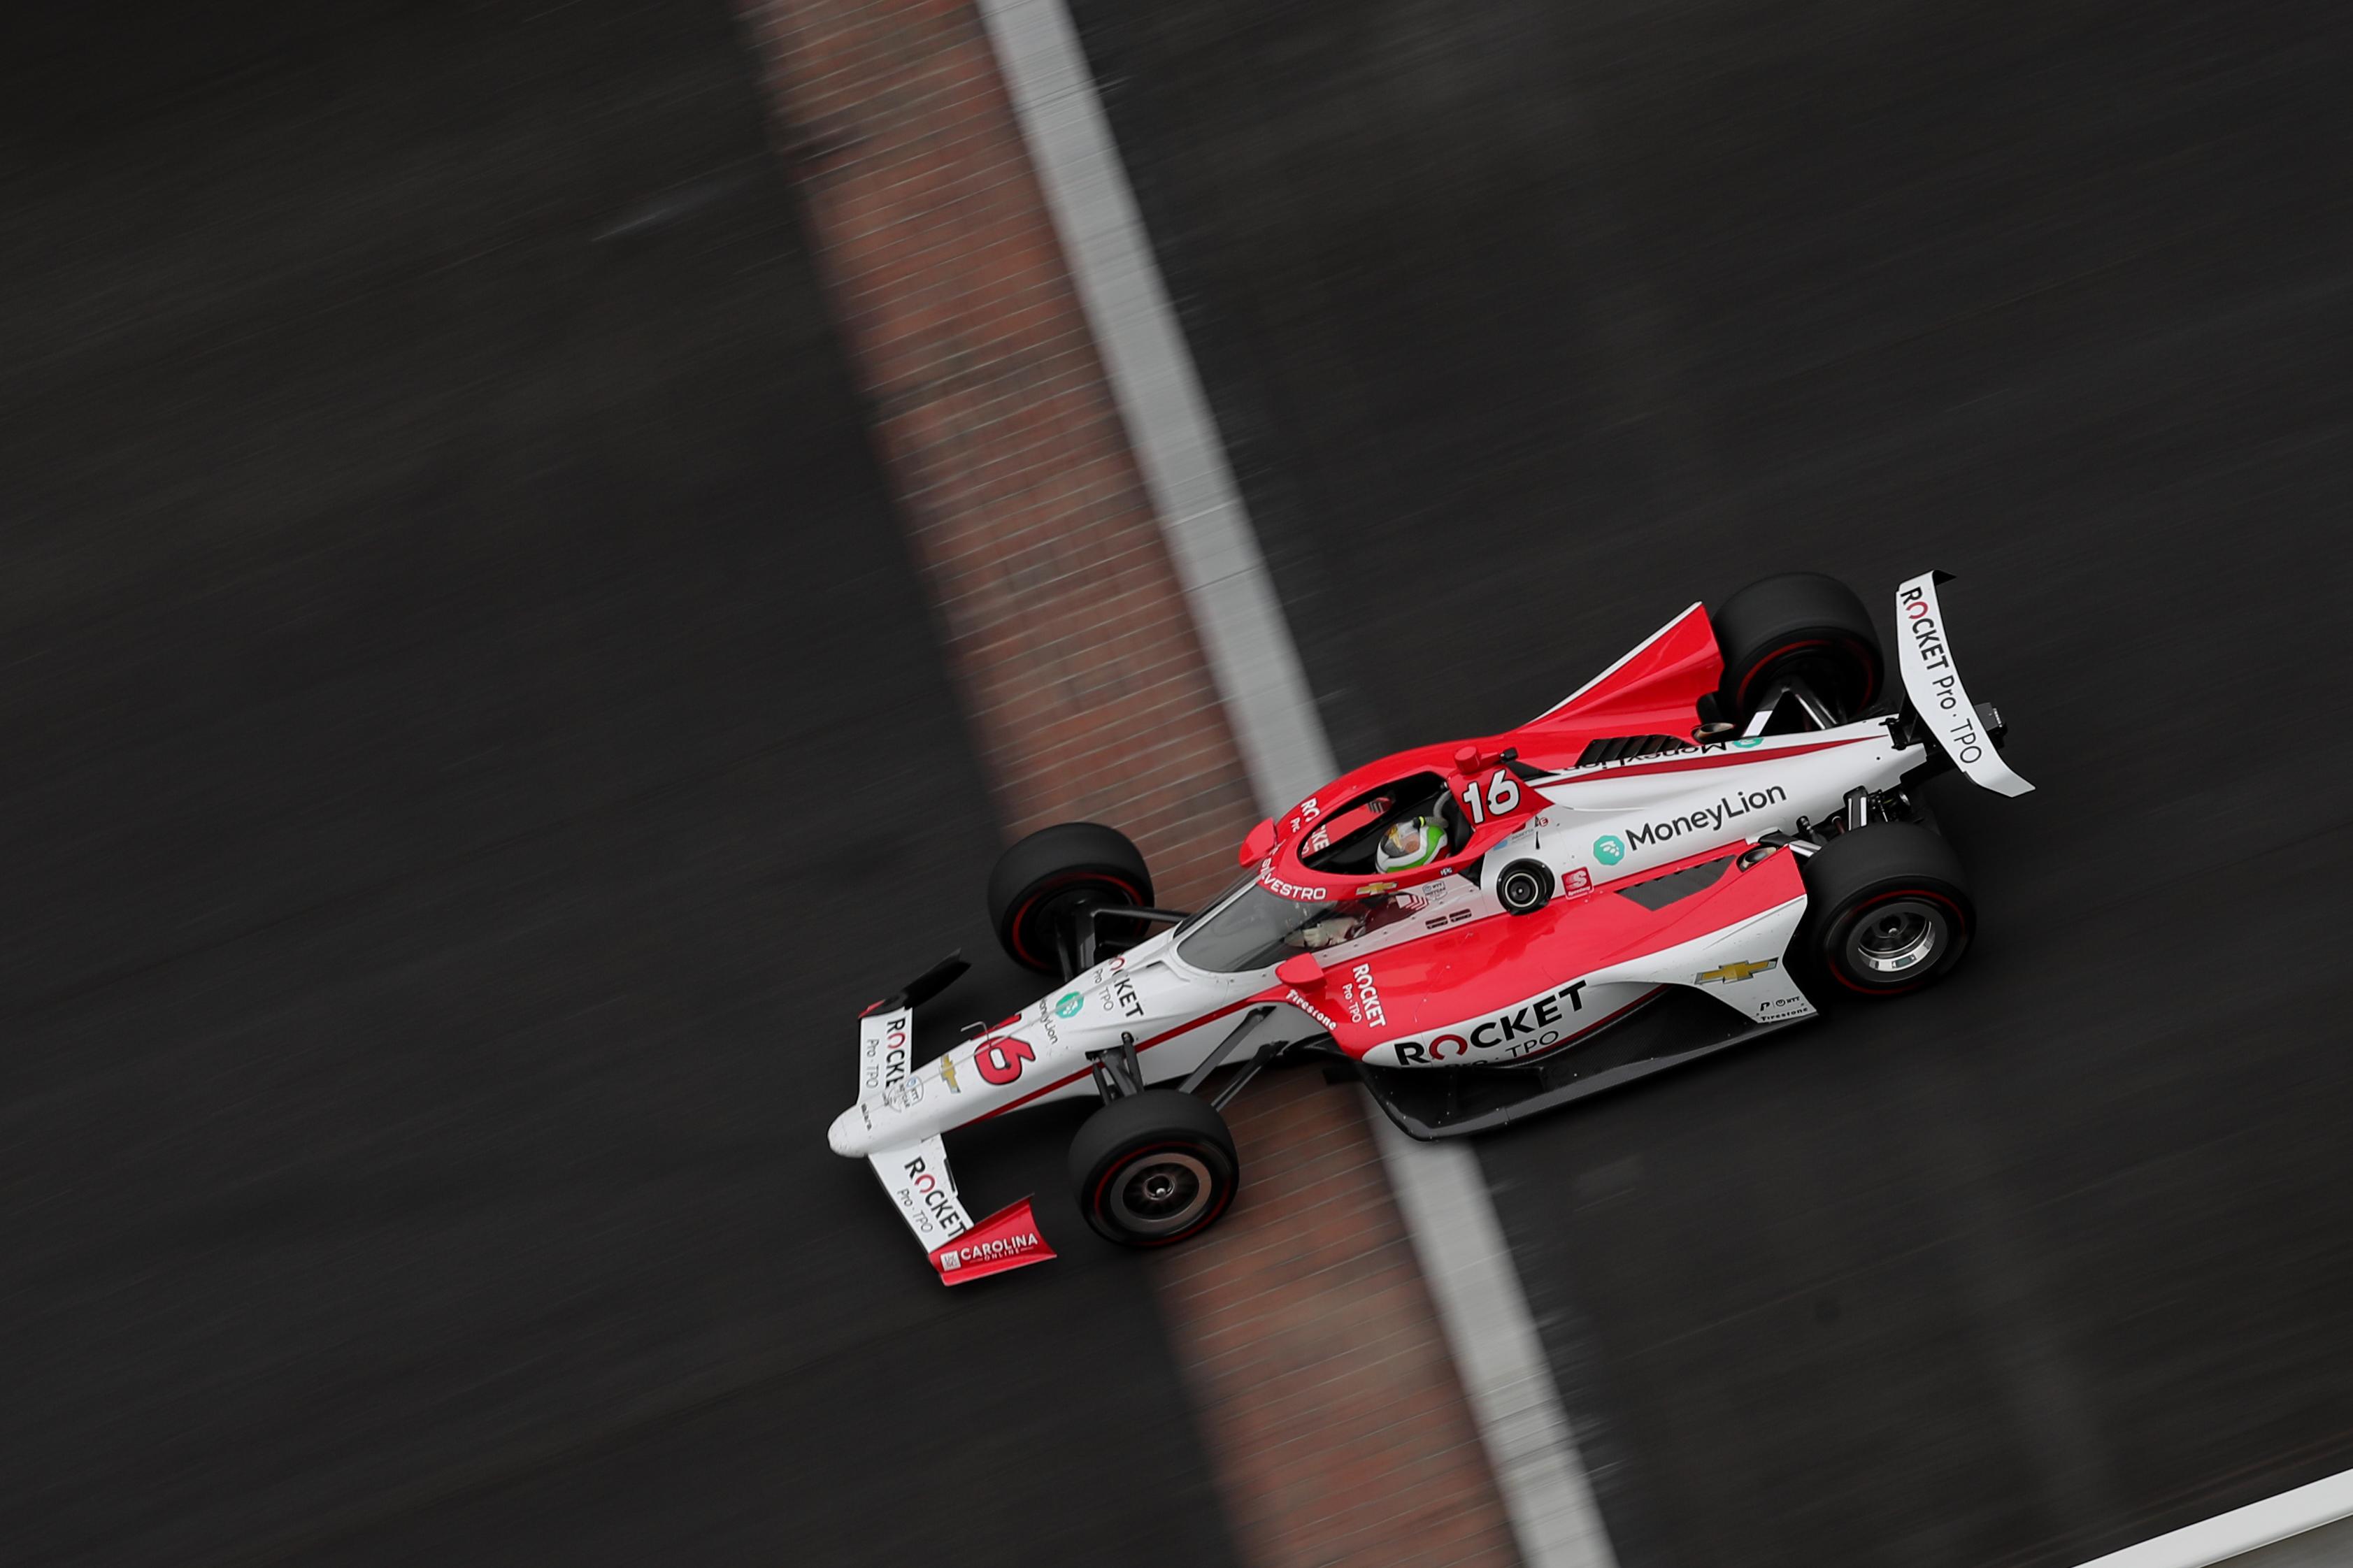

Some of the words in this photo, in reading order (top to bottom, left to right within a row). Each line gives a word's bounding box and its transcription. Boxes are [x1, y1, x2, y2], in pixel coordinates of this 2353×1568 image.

[1900, 587, 1949, 670] ROCKET
[1932, 675, 1957, 710] Pro
[1950, 718, 1982, 763] TPO
[1462, 768, 1520, 824] 16
[1624, 786, 1787, 851] MoneyLion
[1099, 986, 1114, 1011] TPO
[1285, 989, 1337, 1030] Firestone
[1343, 983, 1353, 1000] Pro
[1349, 1002, 1363, 1023] TPO
[1352, 963, 1386, 1028] ROCKET
[1761, 1007, 1808, 1021] Firestone
[1394, 979, 1587, 1066] ROCKET
[1504, 1030, 1559, 1058] TPO
[886, 1017, 906, 1088] ROCKE
[866, 1063, 879, 1089] TPO
[896, 1188, 913, 1207] Pro
[913, 1209, 934, 1233] TPO
[904, 1156, 967, 1237] ROCKET
[960, 1232, 1038, 1260] CAROLINA
